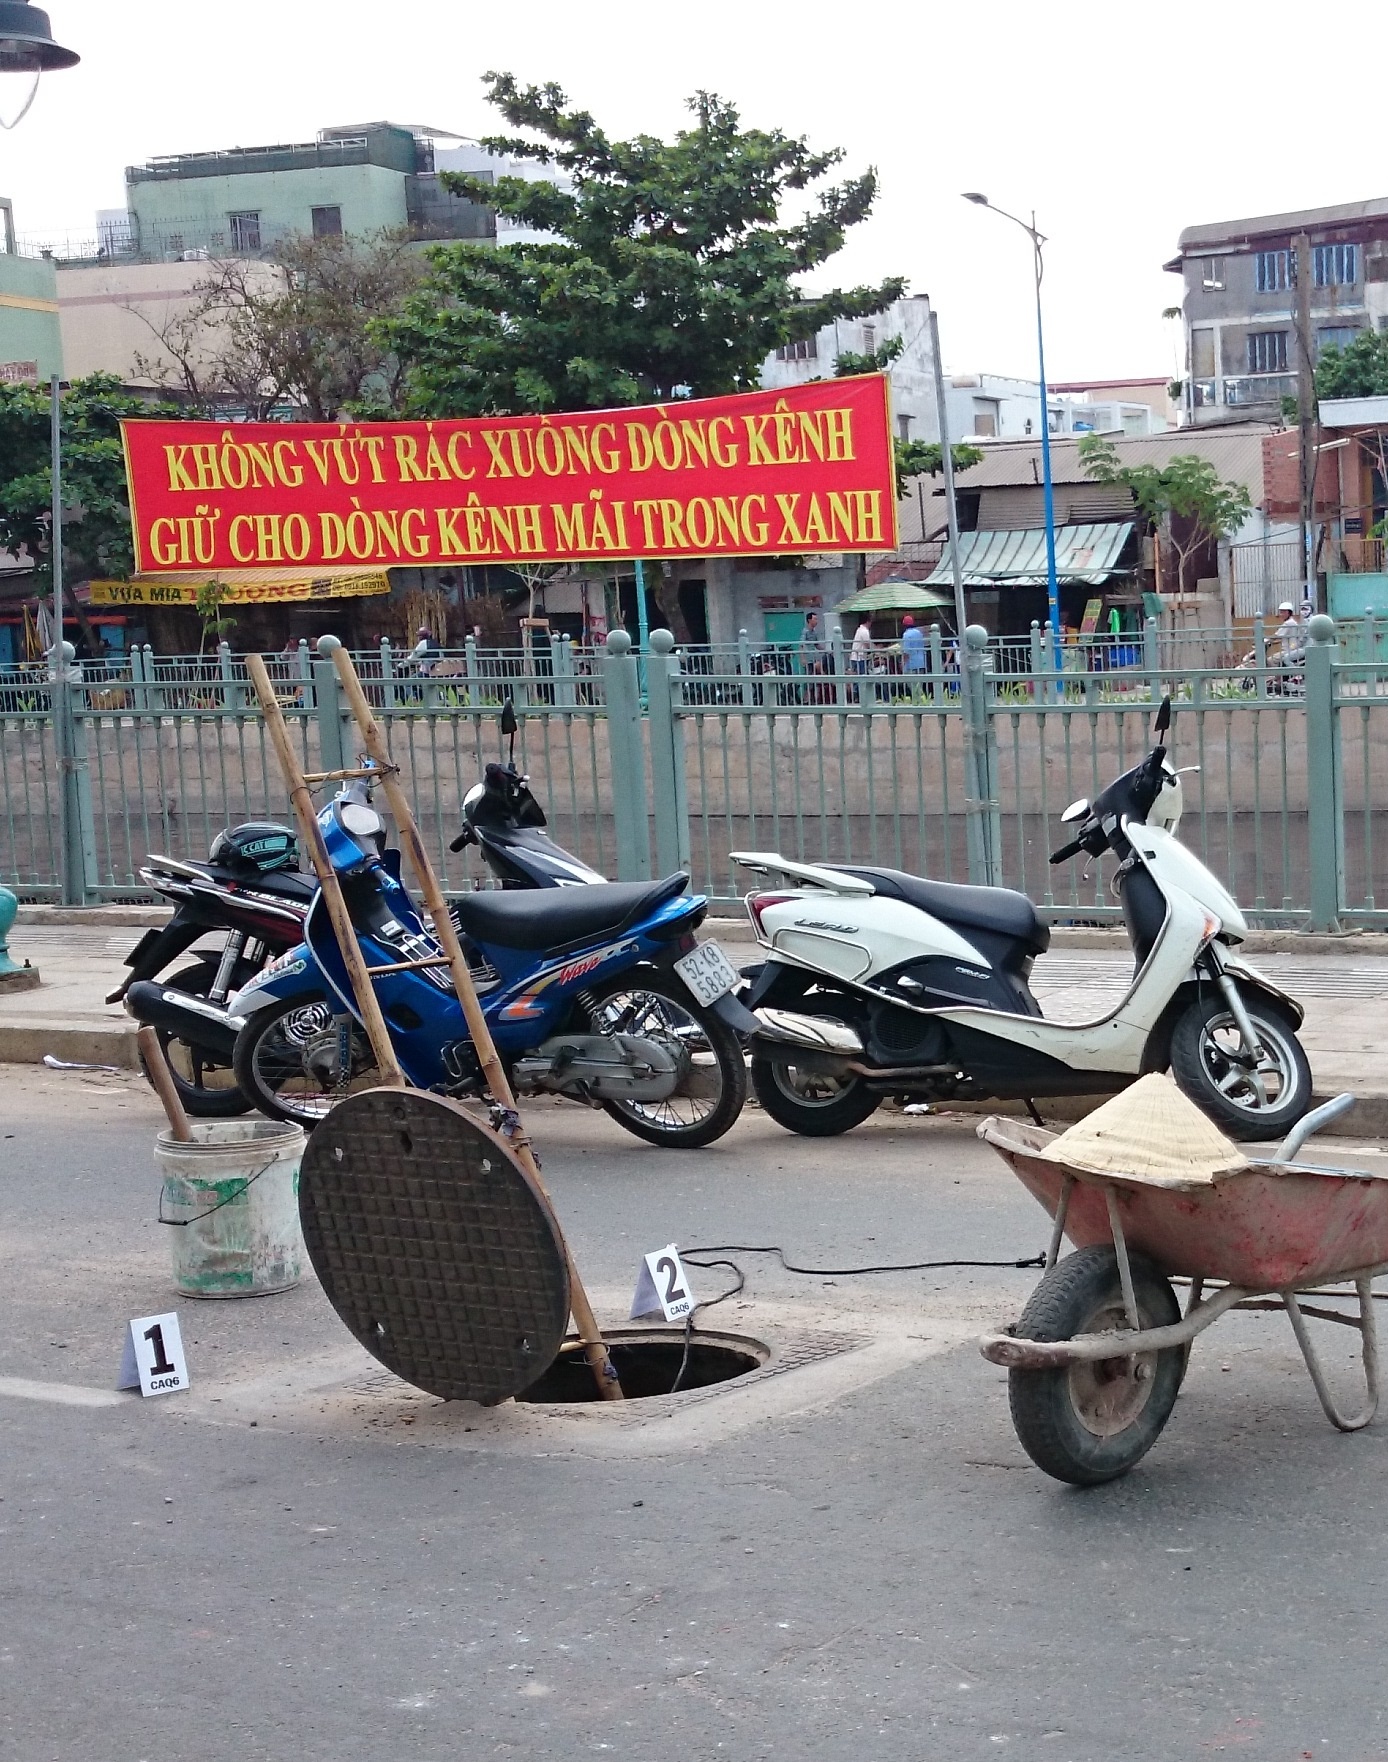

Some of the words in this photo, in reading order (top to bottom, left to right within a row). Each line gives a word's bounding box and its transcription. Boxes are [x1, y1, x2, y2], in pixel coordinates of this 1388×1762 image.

[163, 429, 303, 491] KHÔNG
[305, 424, 386, 486] VỨT
[392, 422, 475, 482] RÁC
[624, 407, 739, 472] DÒNG
[741, 398, 856, 466] KÊNH
[150, 504, 221, 565] GIỮ
[229, 513, 311, 562] CHO
[318, 496, 430, 559] DÒNG
[434, 491, 547, 555] KÊNH
[552, 488, 631, 552] MÃI
[634, 493, 770, 549] TRONG
[773, 489, 885, 544] XANH
[558, 956, 602, 986] Wave
[697, 964, 734, 999] 5883
[657, 1256, 686, 1304] 2
[670, 1302, 690, 1316] CAQ6
[143, 1323, 176, 1377] 1
[150, 1376, 180, 1390] CAQ6
